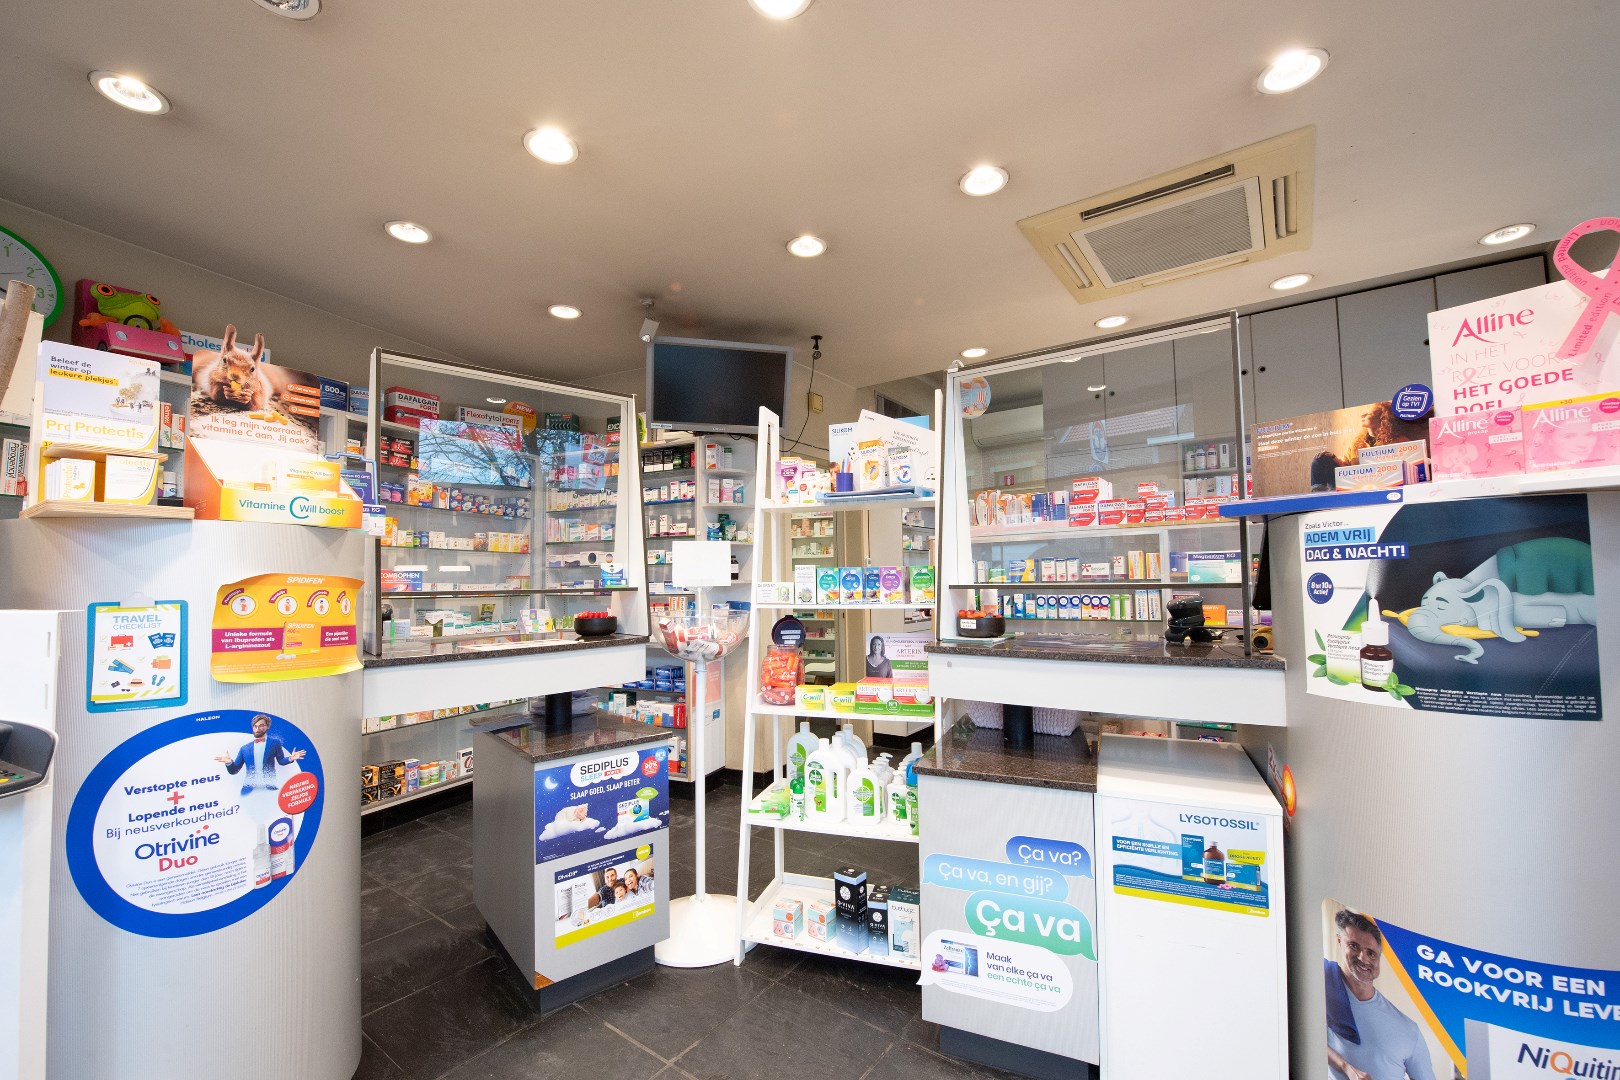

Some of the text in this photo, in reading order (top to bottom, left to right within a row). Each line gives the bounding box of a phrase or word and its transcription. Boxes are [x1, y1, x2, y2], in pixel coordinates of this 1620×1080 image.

[26, 267, 35, 278] 2
[37, 288, 44, 298] 3
[1451, 308, 1535, 347] Alline
[1568, 324, 1593, 357] Limited
[1451, 342, 1510, 367] IN HET
[324, 385, 340, 394] 500
[1454, 368, 1574, 400] HET GOEDE
[398, 394, 438, 407] DAFALGAN
[420, 404, 438, 412] FORTE
[516, 404, 533, 413] NEW
[211, 416, 302, 436] Ik leg mijn voorraad
[1532, 405, 1592, 429] Alline
[74, 421, 144, 439] Protectis
[202, 423, 243, 436] vitamine
[246, 429, 252, 438] C
[278, 434, 288, 444] Jij
[1436, 418, 1488, 440] Alline
[1362, 444, 1418, 458] FULTIUM 2000
[1338, 464, 1398, 476] FULTIUM 2000
[239, 496, 345, 520] Vitamine C Will boost
[1306, 528, 1371, 544] ADEM VRIJ
[1306, 545, 1406, 560] DAG & NACHT!
[286, 576, 323, 584] SPIDIFEN
[112, 614, 162, 624] TRAVEL
[112, 622, 162, 630] CHECKLIST
[234, 636, 264, 644] Ibuprofen
[580, 757, 629, 776] SEDIPLUS
[124, 774, 222, 796] Verstopte neus
[580, 772, 602, 782] SLEEP
[570, 790, 588, 800] SLAAP
[606, 782, 623, 792] SLAAP
[624, 778, 640, 788] BETER
[128, 799, 219, 824] Lopende neus
[106, 804, 240, 840] Bij neusverkoudheid?
[1179, 814, 1258, 831] LYSOTOSSIL
[134, 824, 220, 860] Otrivine
[158, 855, 198, 872] Duo
[1018, 844, 1082, 866] Ça va?
[938, 862, 1054, 896] Ça va, en gij?
[976, 900, 1081, 943] Ça va
[986, 951, 1012, 964] Maak
[986, 964, 1054, 982] van elke ça va
[1416, 944, 1606, 997] GA VOOR EEN
[987, 972, 1061, 994] een echte ça va
[1418, 964, 1553, 1012] ROOKVRIJ
